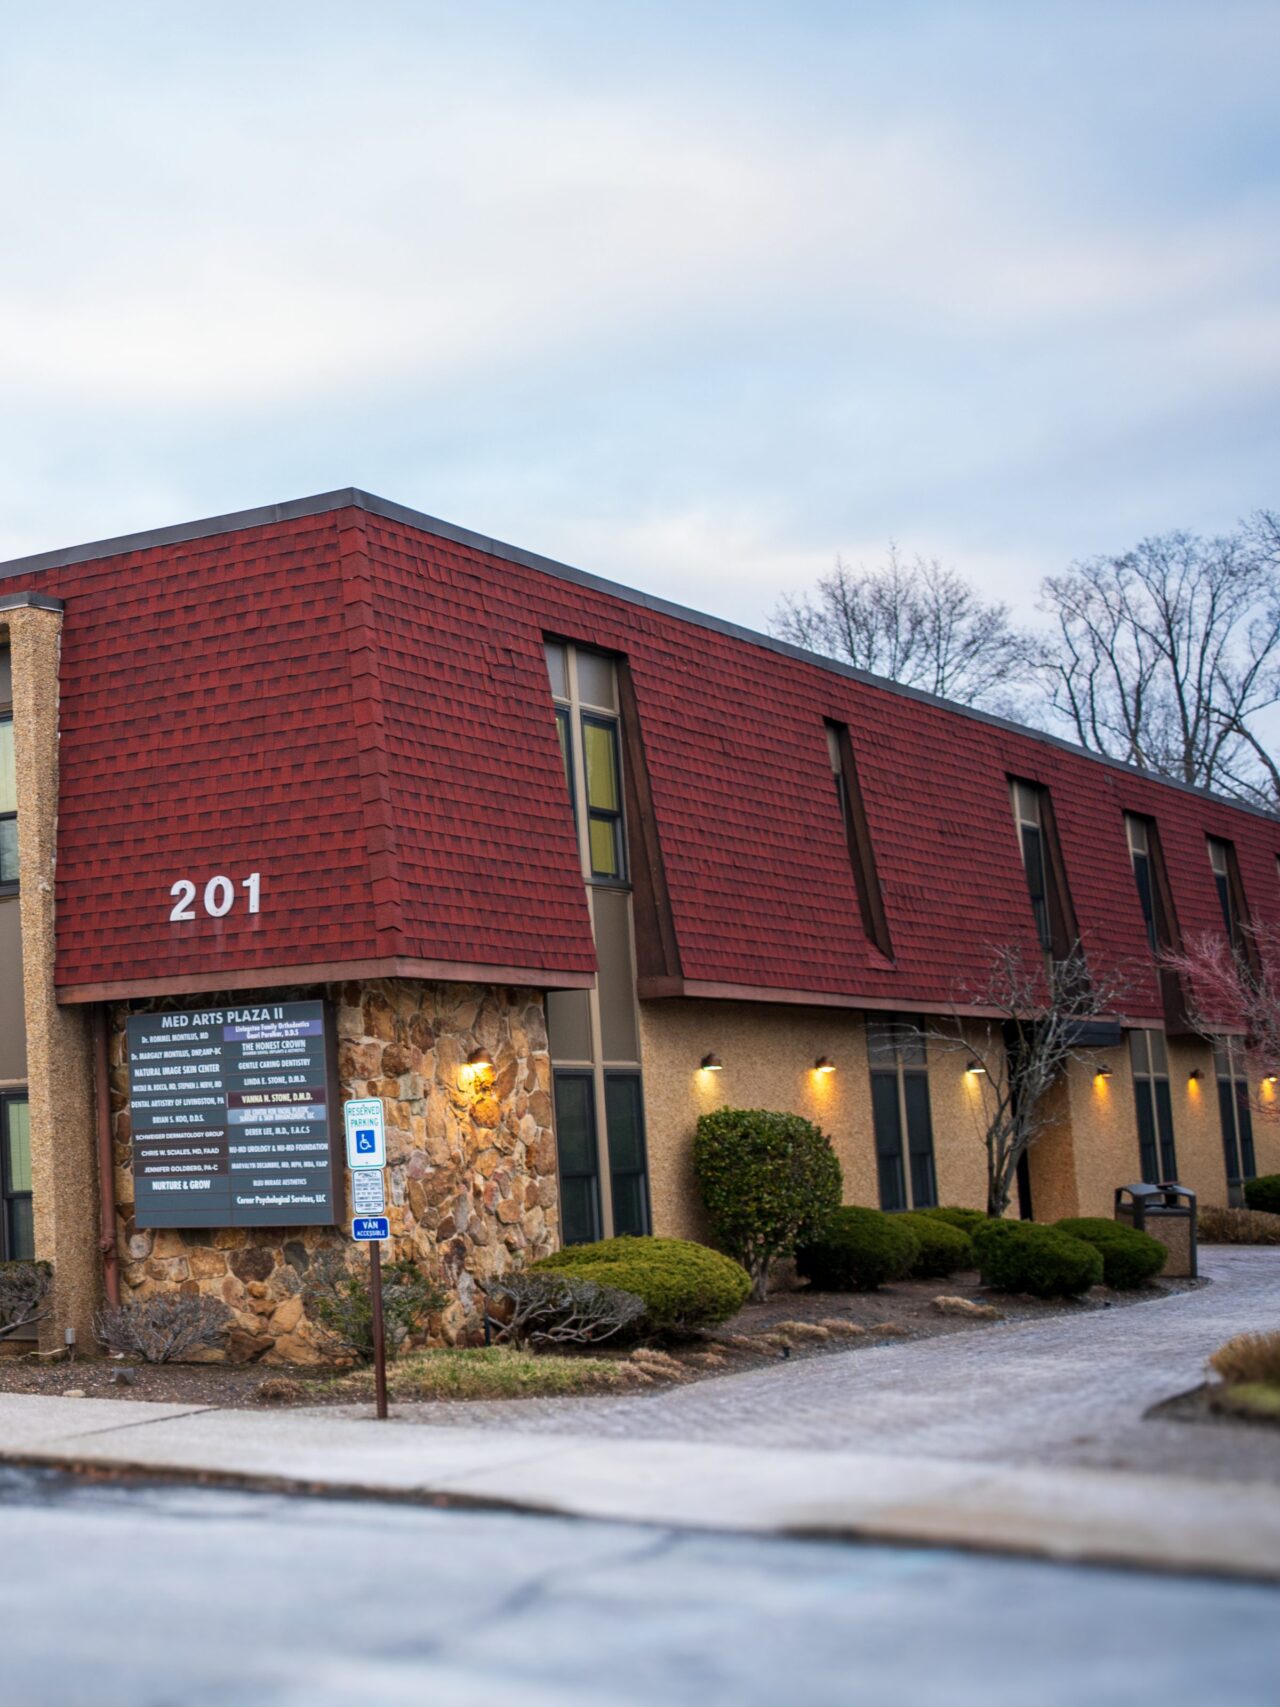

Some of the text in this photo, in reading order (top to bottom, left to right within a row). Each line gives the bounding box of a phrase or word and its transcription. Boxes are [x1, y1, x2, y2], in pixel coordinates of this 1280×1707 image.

[169, 873, 261, 921] 201
[162, 1008, 283, 1028] MED ARTS PLAZA II
[261, 1023, 277, 1031] Family
[278, 1021, 309, 1029] Orthodontics
[242, 1040, 306, 1051] THE HONEST CROWN
[238, 1059, 310, 1070] GENTLE CARING DENTISTRY
[134, 1064, 220, 1077] NATURAL IMAGE SKIN CENTER
[268, 1077, 287, 1085] STONE,
[241, 1096, 262, 1104] VANNA
[272, 1094, 292, 1102] STONE,
[293, 1093, 312, 1101] D.M.D.
[348, 1106, 380, 1115] RESERVED
[351, 1118, 379, 1127] PARKING
[245, 1128, 262, 1136] DEREK
[263, 1128, 274, 1136] LEE,
[152, 1180, 210, 1190] NURTURE & GROW
[255, 1195, 290, 1205] Psychological
[291, 1195, 315, 1203] Services,
[316, 1194, 326, 1202] LLC
[363, 1221, 378, 1229] VAN
